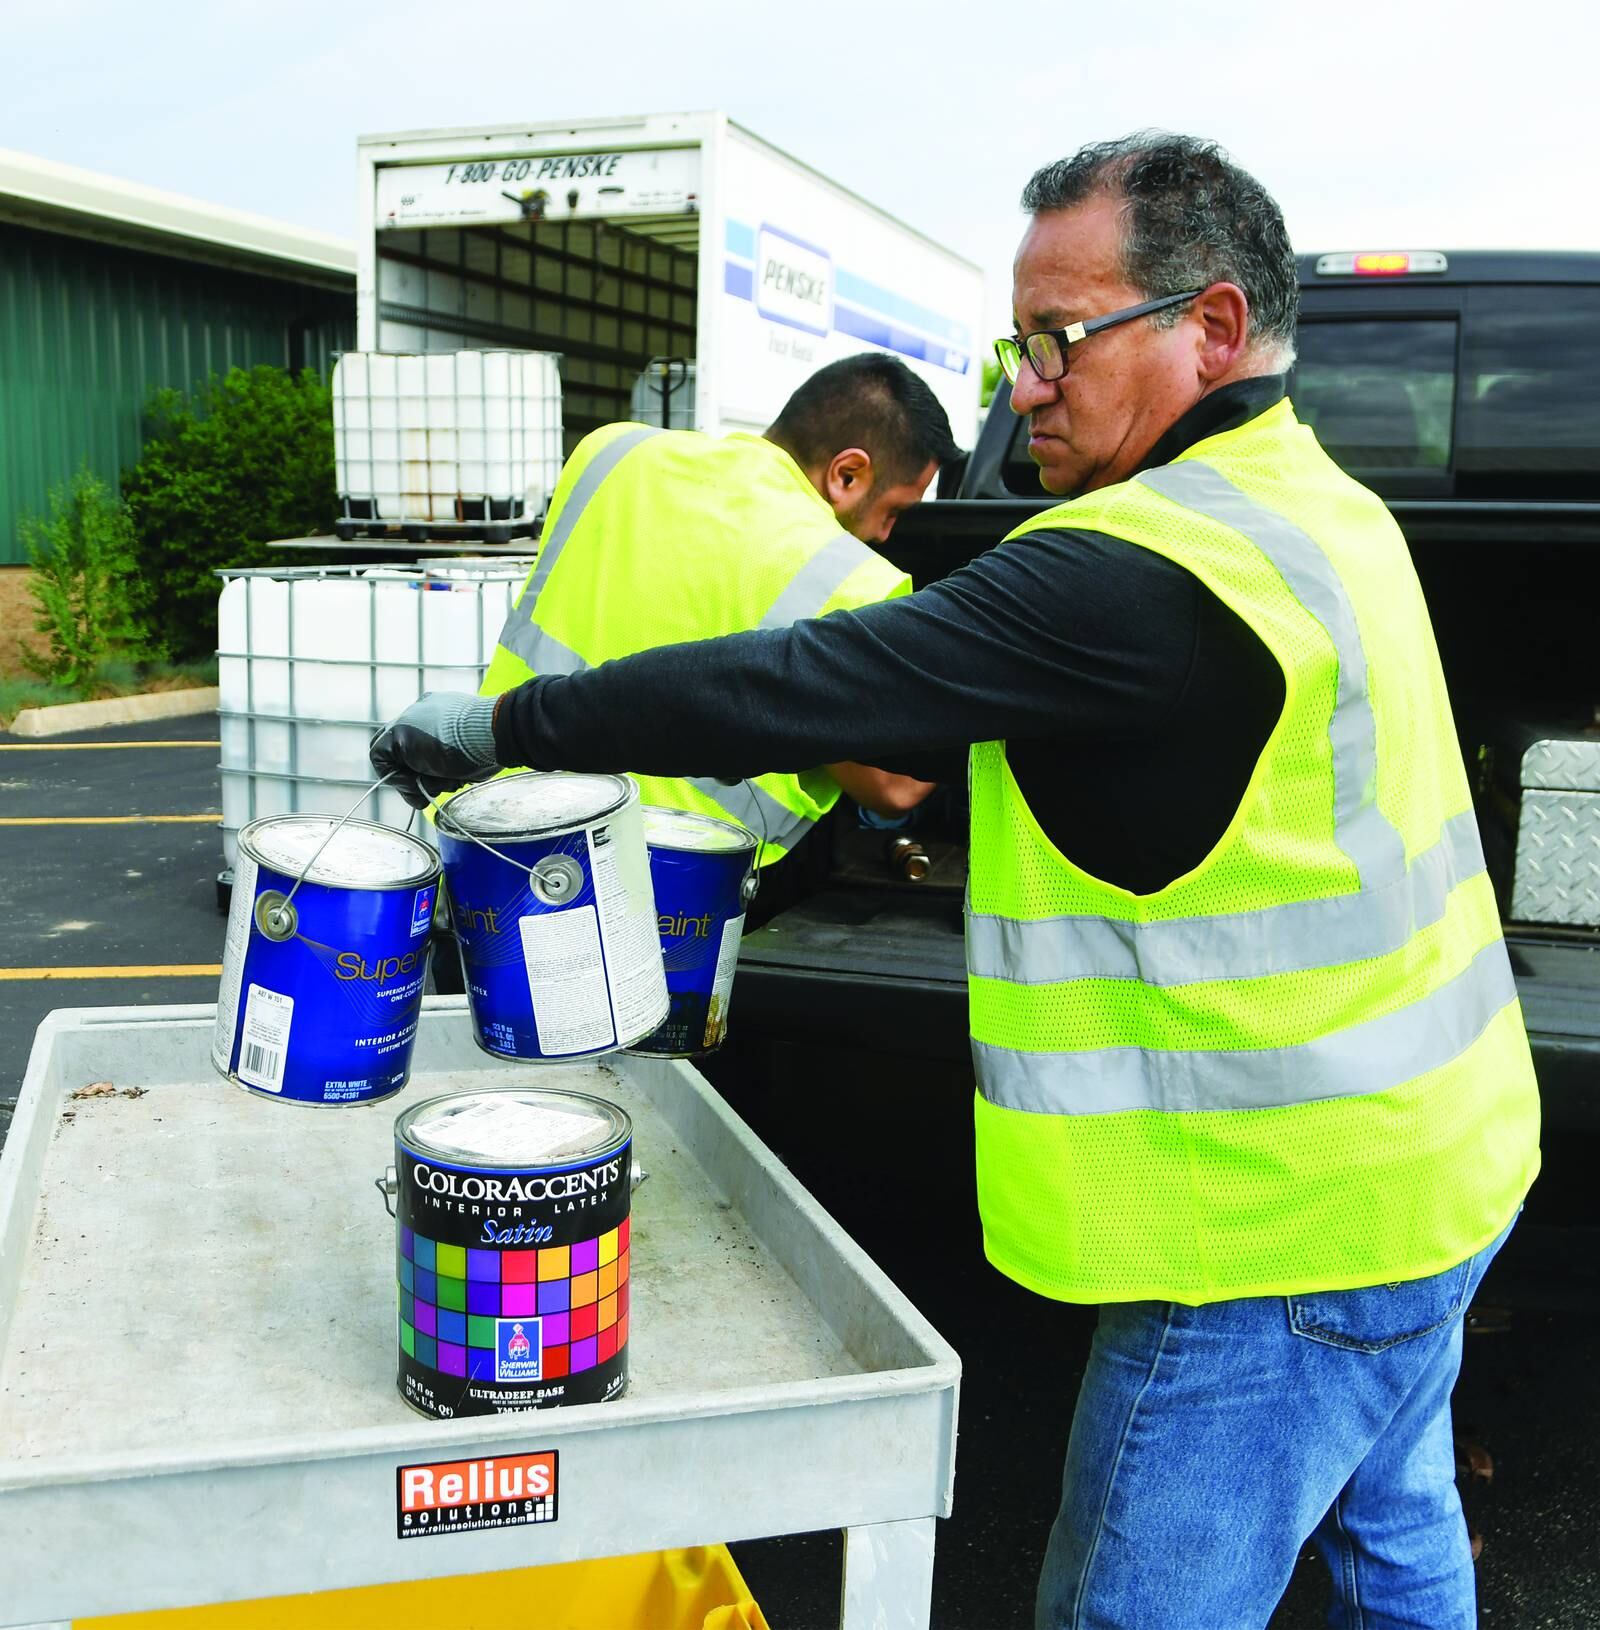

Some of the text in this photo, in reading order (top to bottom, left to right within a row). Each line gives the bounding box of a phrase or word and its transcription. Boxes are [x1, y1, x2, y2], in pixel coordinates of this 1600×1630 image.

[446, 154, 623, 185] 1-800-GO-PENSKE
[763, 258, 826, 306] PENSKE
[658, 911, 711, 937] aint
[376, 985, 406, 998] SUPERIOR
[354, 1033, 396, 1047] INTERIOR
[325, 1081, 347, 1089] EXTRA
[348, 1079, 368, 1088] WHITE
[424, 1191, 609, 1218] INTERIOR LATEX
[480, 1218, 553, 1244] Satin
[499, 1367, 539, 1378] WILLIAMS
[500, 1360, 538, 1369] SHERWIN
[469, 1385, 565, 1400] ULTRADEEP BASE
[422, 1396, 437, 1411] U.S.
[438, 1404, 454, 1418] Qt)
[404, 1460, 550, 1509] Relius
[404, 1500, 533, 1526] solutions
[402, 1514, 526, 1536] www.reliussolutions.com
